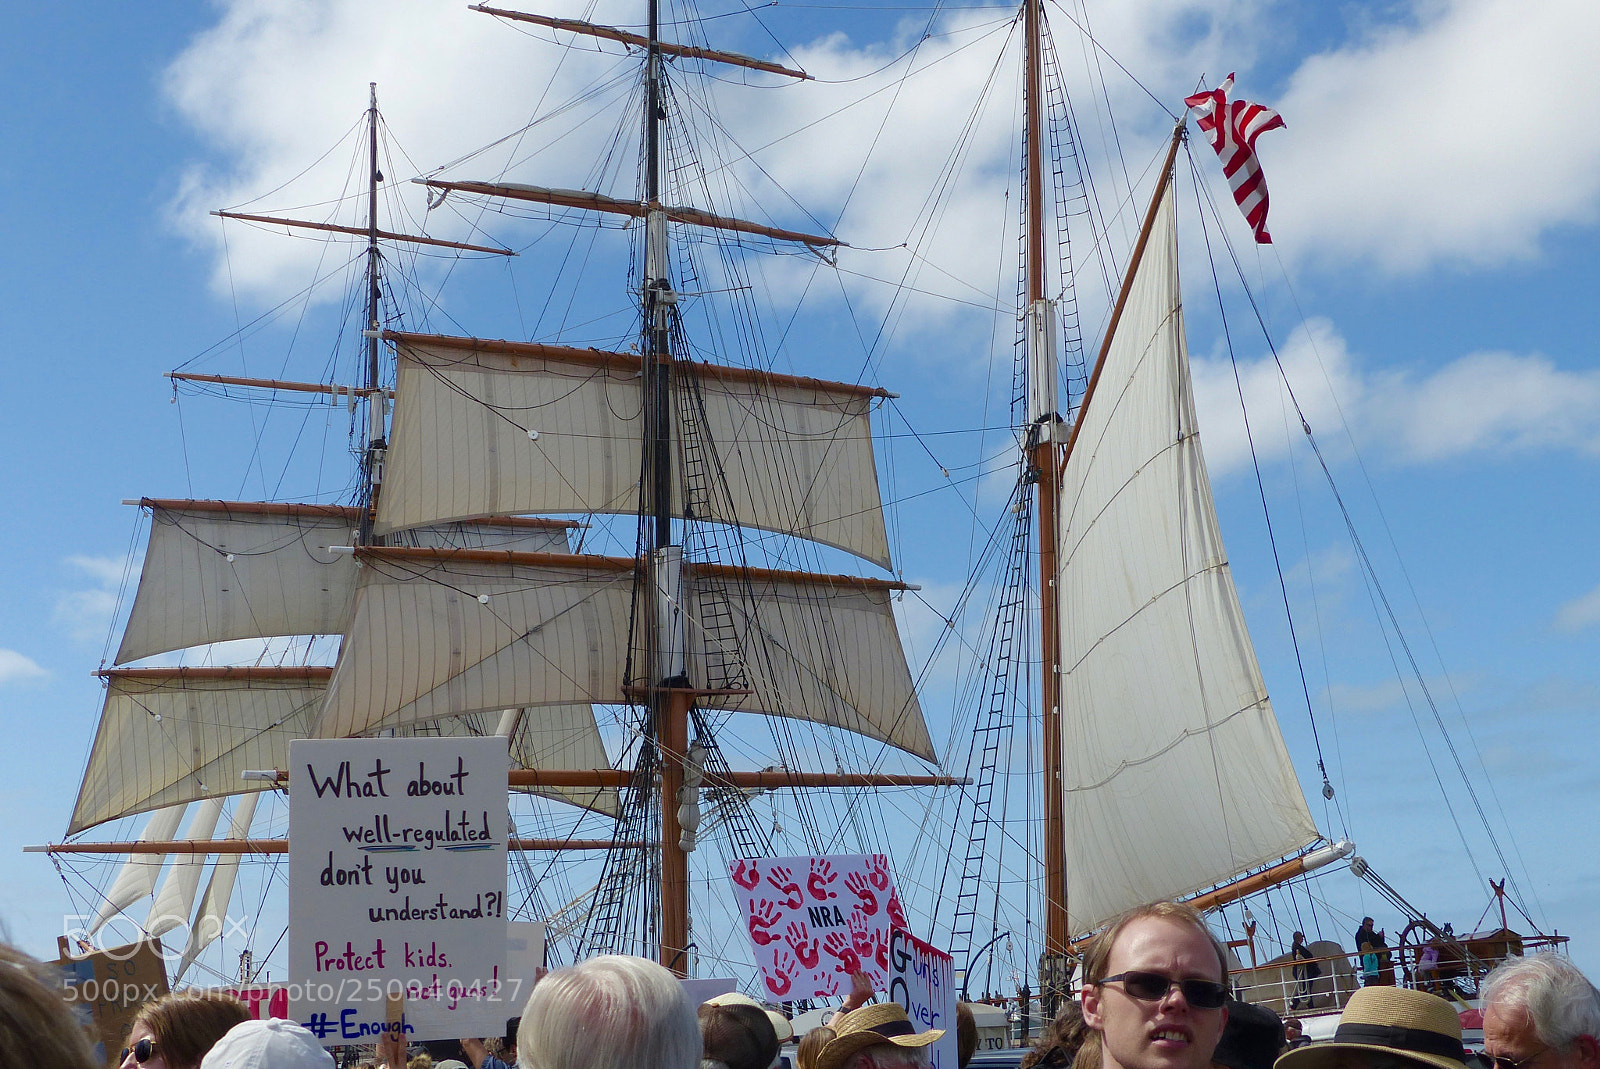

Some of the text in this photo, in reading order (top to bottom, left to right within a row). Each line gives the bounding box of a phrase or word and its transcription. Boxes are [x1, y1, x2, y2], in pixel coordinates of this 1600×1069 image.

[307, 756, 469, 798] What about
[342, 809, 492, 850] well-regulated
[320, 851, 426, 894] don't you
[368, 891, 503, 923] understand?!
[807, 905, 846, 928] NRA
[314, 938, 452, 972] Protect kids.
[406, 973, 443, 1000] not
[301, 1008, 415, 1042] #Enough
